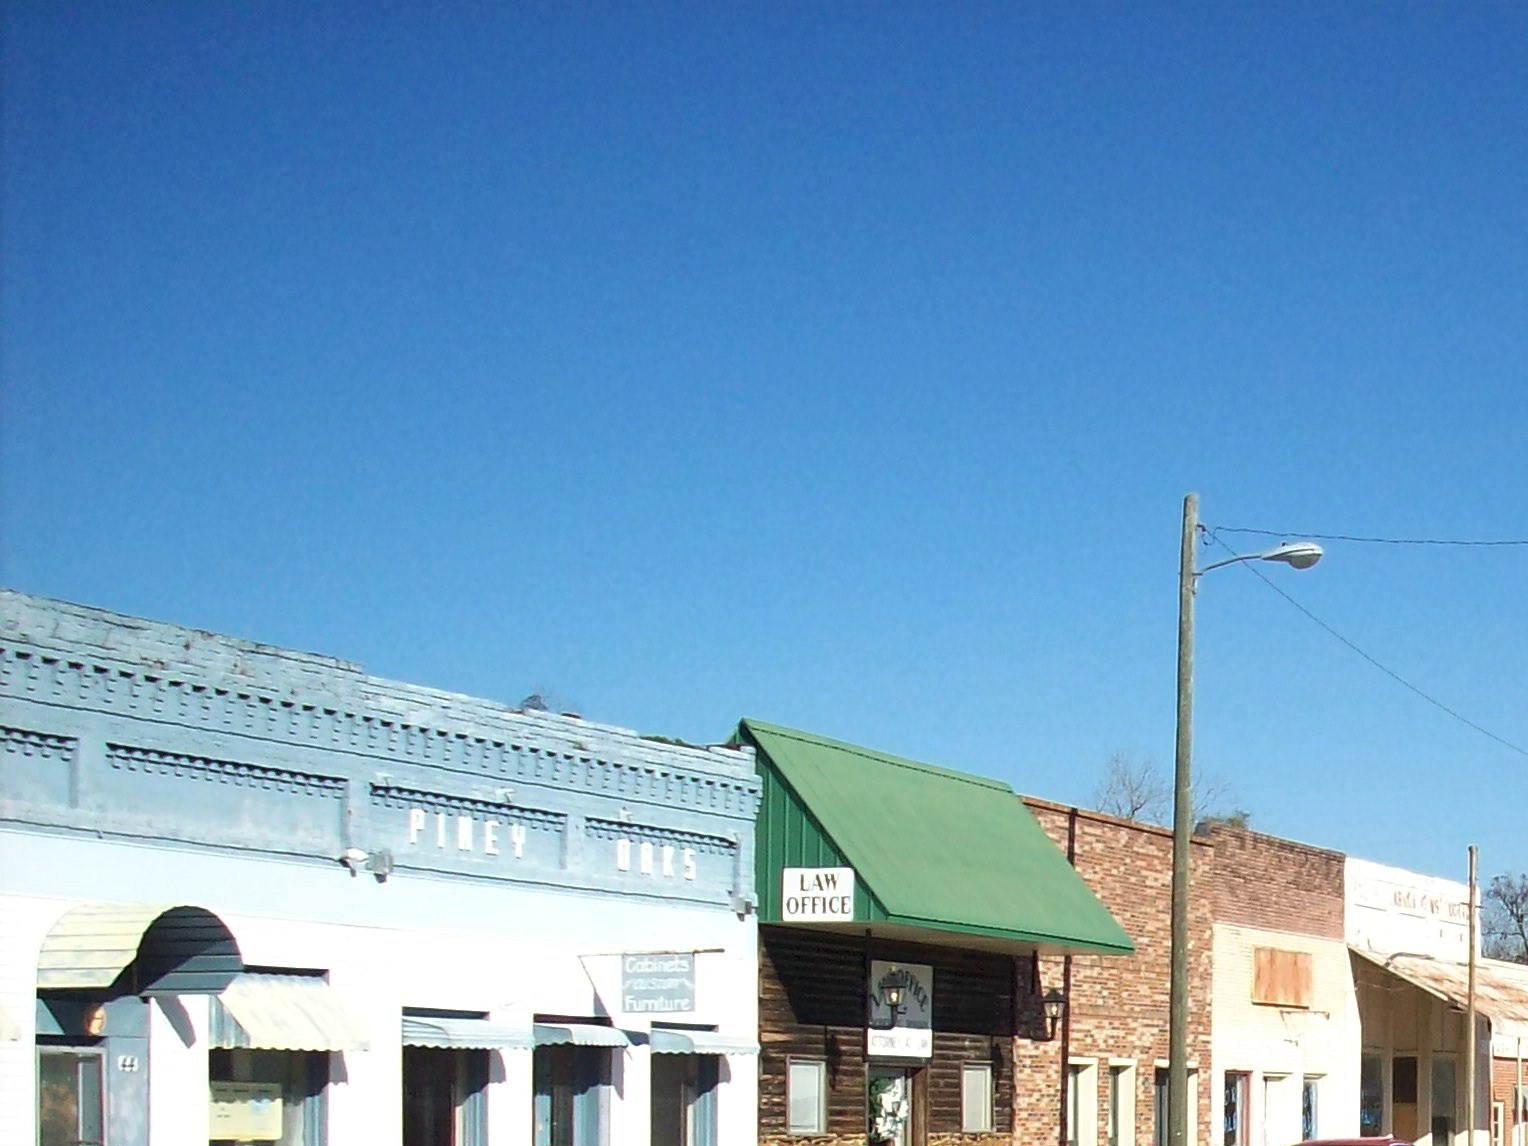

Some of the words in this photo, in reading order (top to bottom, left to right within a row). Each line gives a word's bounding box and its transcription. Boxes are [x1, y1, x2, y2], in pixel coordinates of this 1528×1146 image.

[408, 807, 527, 859] PINEY
[615, 837, 698, 881] OAKS
[800, 873, 838, 892] LAW
[786, 896, 852, 915] OFFICE
[625, 956, 690, 973] Cabinets
[625, 994, 691, 1012] Furniture
